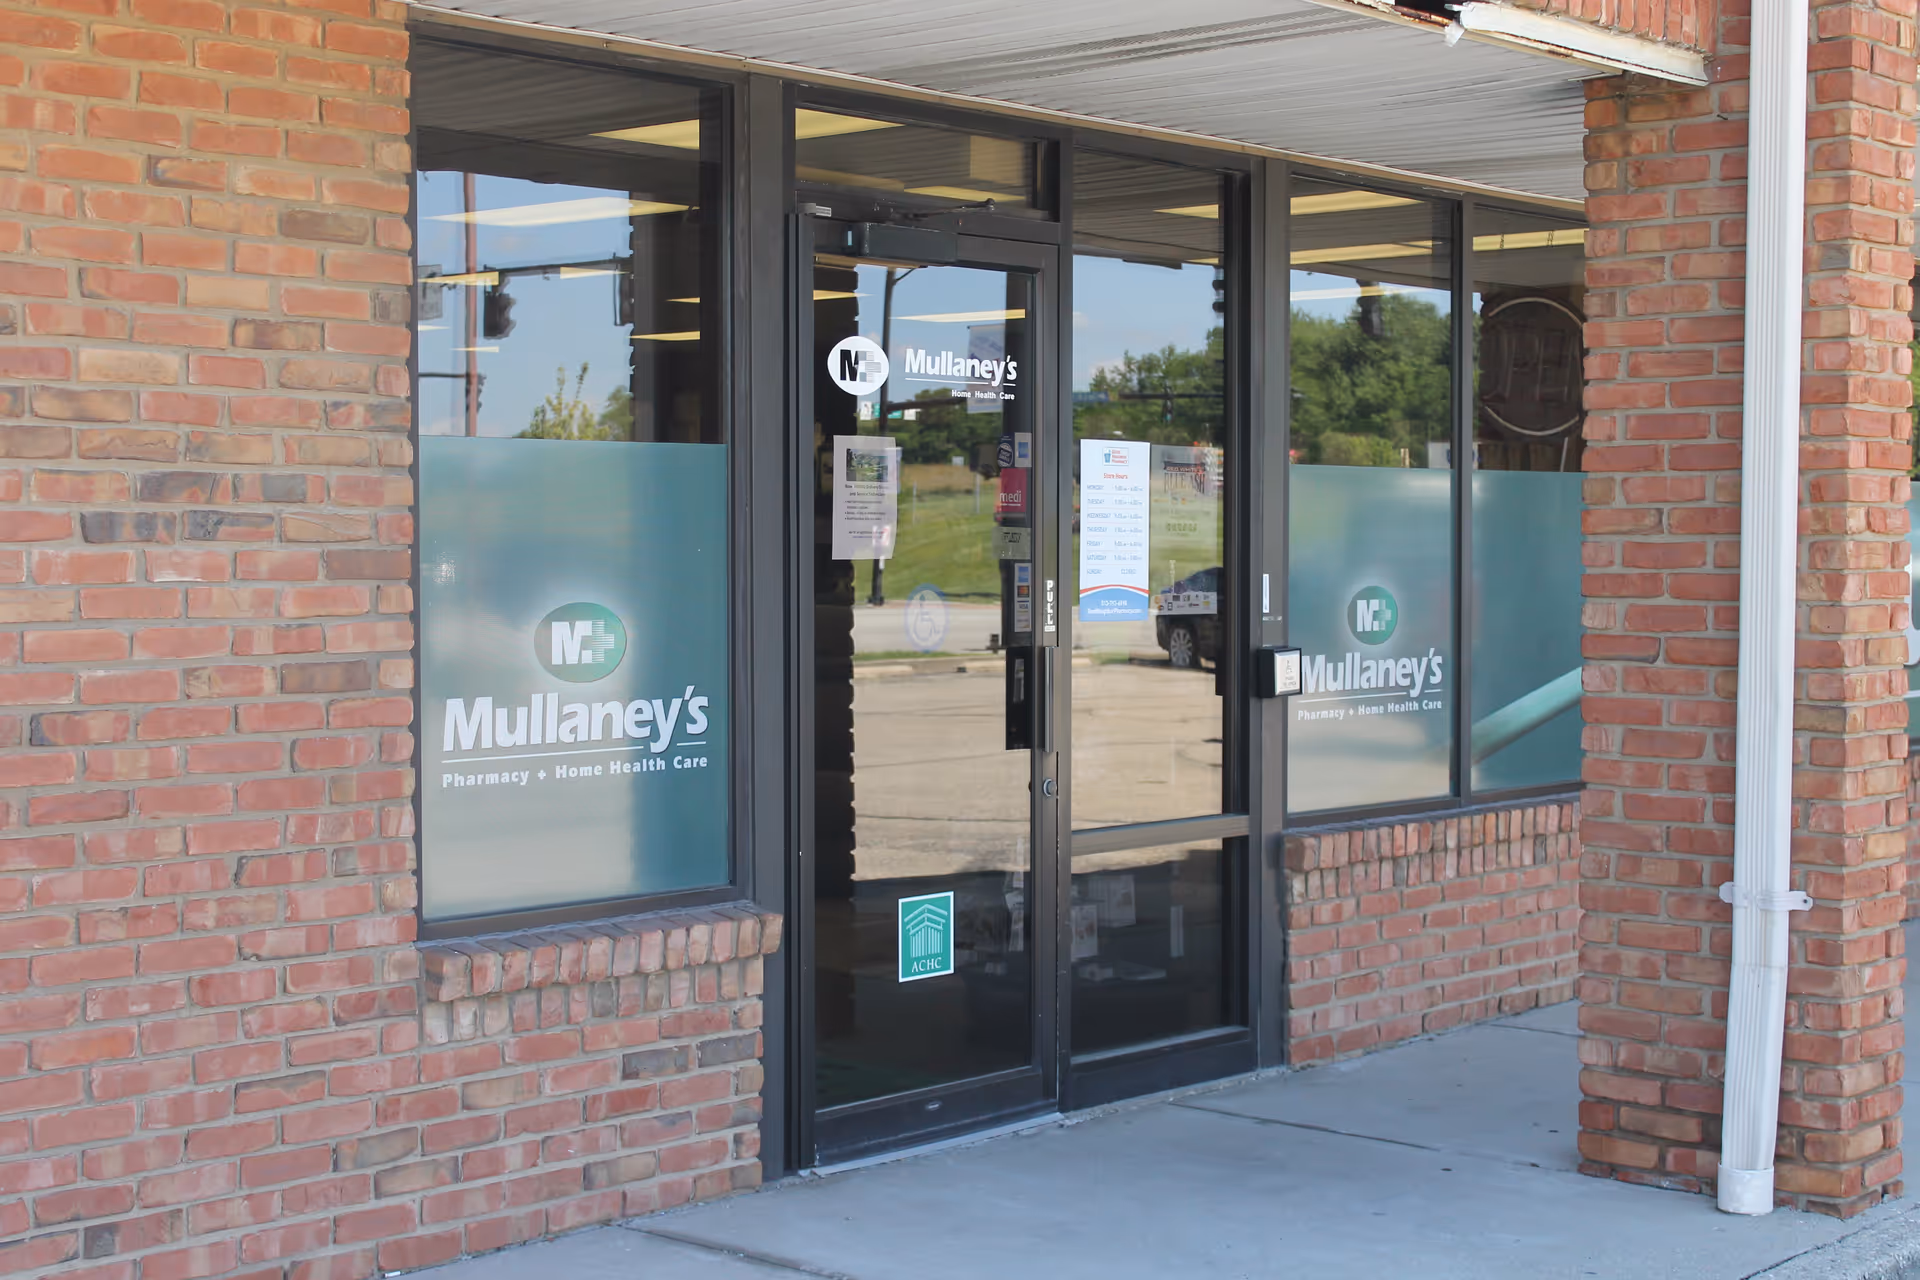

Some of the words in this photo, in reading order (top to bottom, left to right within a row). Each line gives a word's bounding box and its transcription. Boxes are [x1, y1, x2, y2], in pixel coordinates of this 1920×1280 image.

[904, 347, 1018, 388] Mullaney's
[951, 389, 972, 399] Home
[974, 390, 997, 400] Health
[999, 391, 1016, 401] Care
[999, 489, 1022, 503] medi
[1046, 579, 1054, 625] PULL
[1301, 647, 1443, 698] Mullaney's
[442, 685, 709, 754] Mullaney's
[1297, 707, 1345, 721] Pharmacy
[1357, 704, 1385, 716] Home
[1387, 700, 1420, 714] Health
[1422, 699, 1443, 711] Care
[441, 768, 530, 788] Pharmacy
[555, 763, 603, 780] Home
[609, 756, 666, 775] Health
[673, 754, 708, 769] Care
[911, 957, 942, 973] ACHC
